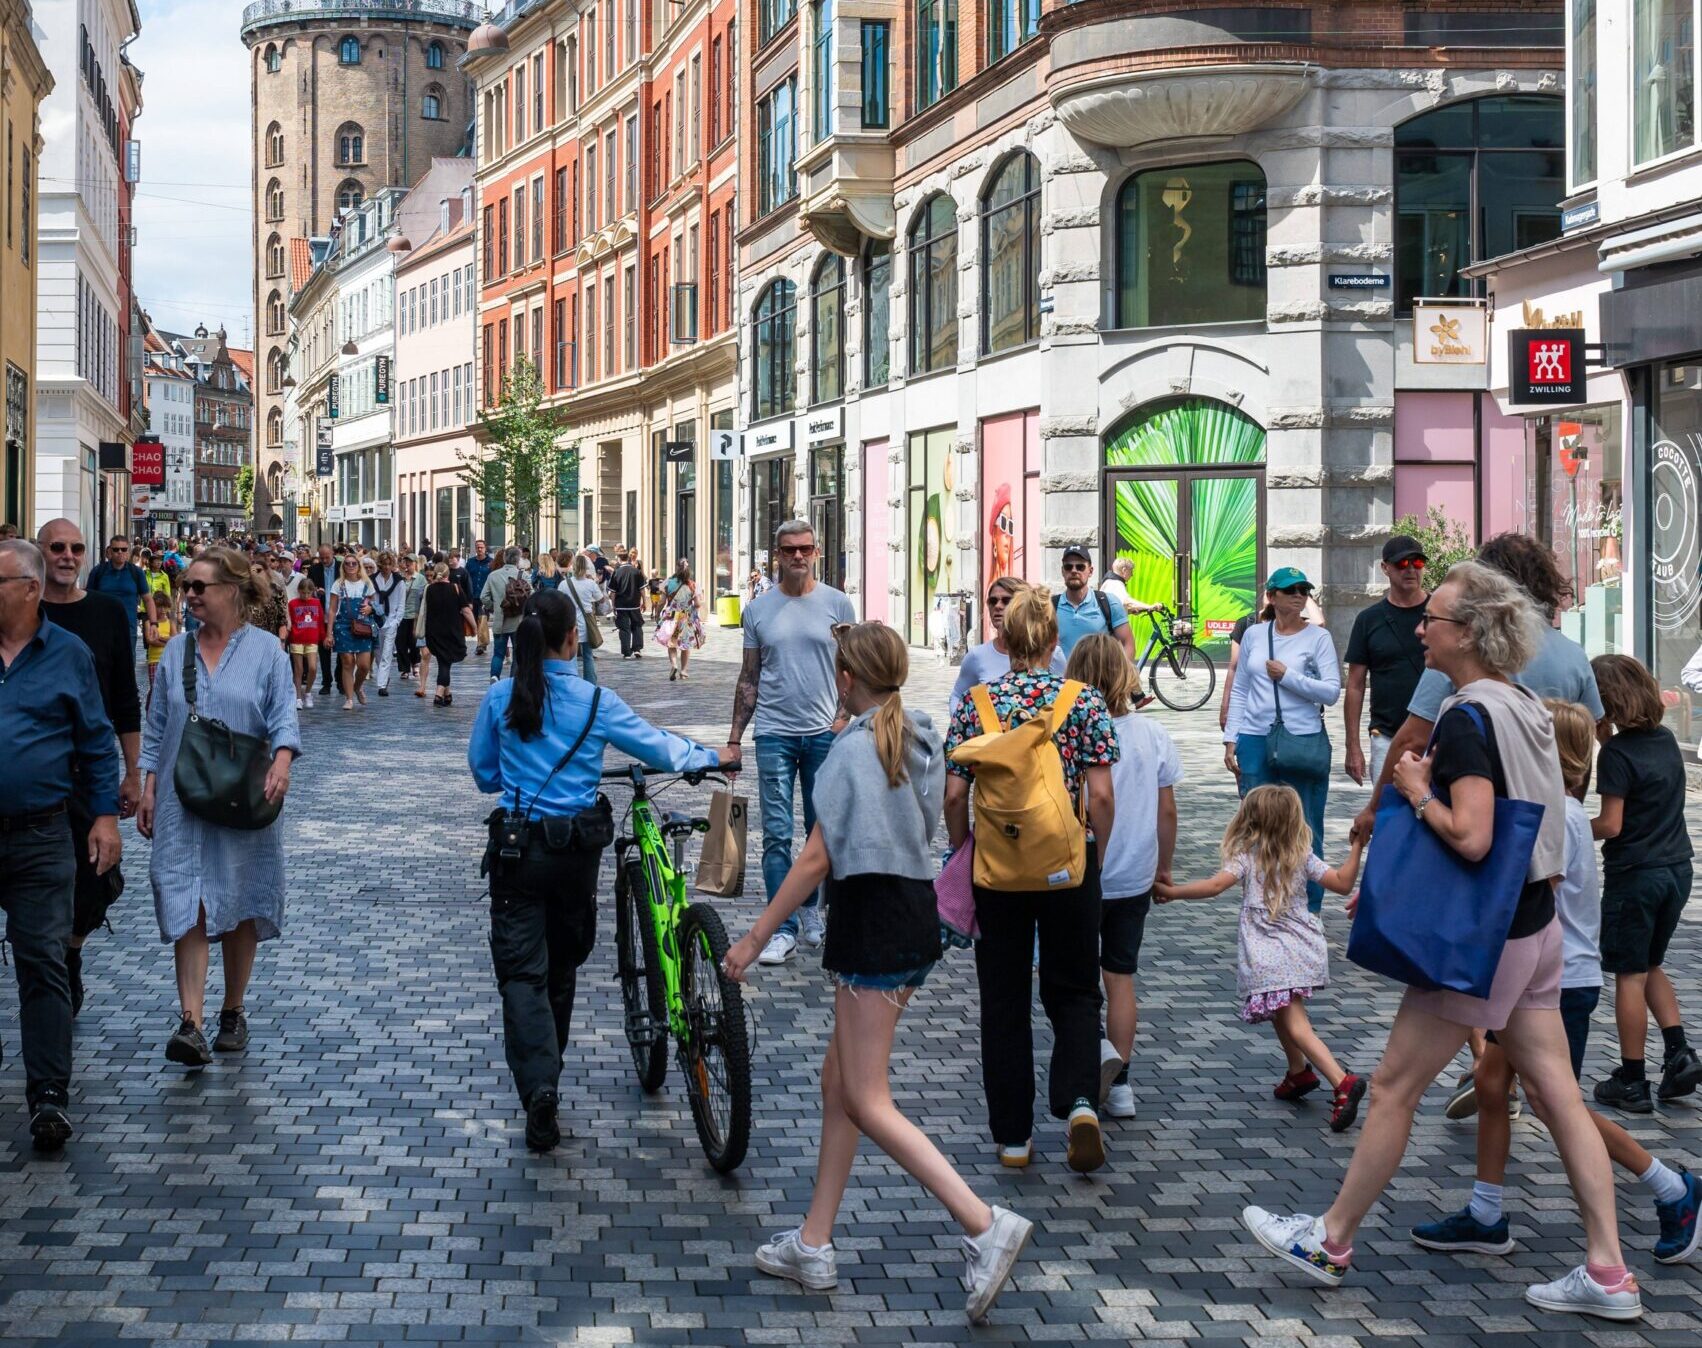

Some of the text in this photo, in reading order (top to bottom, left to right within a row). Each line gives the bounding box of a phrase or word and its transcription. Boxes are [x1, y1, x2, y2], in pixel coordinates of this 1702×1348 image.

[378, 358, 386, 394] PUREGYM
[132, 453, 161, 461] CHAO
[1658, 446, 1692, 489] COCOTTE
[131, 466, 161, 474] CHAO
